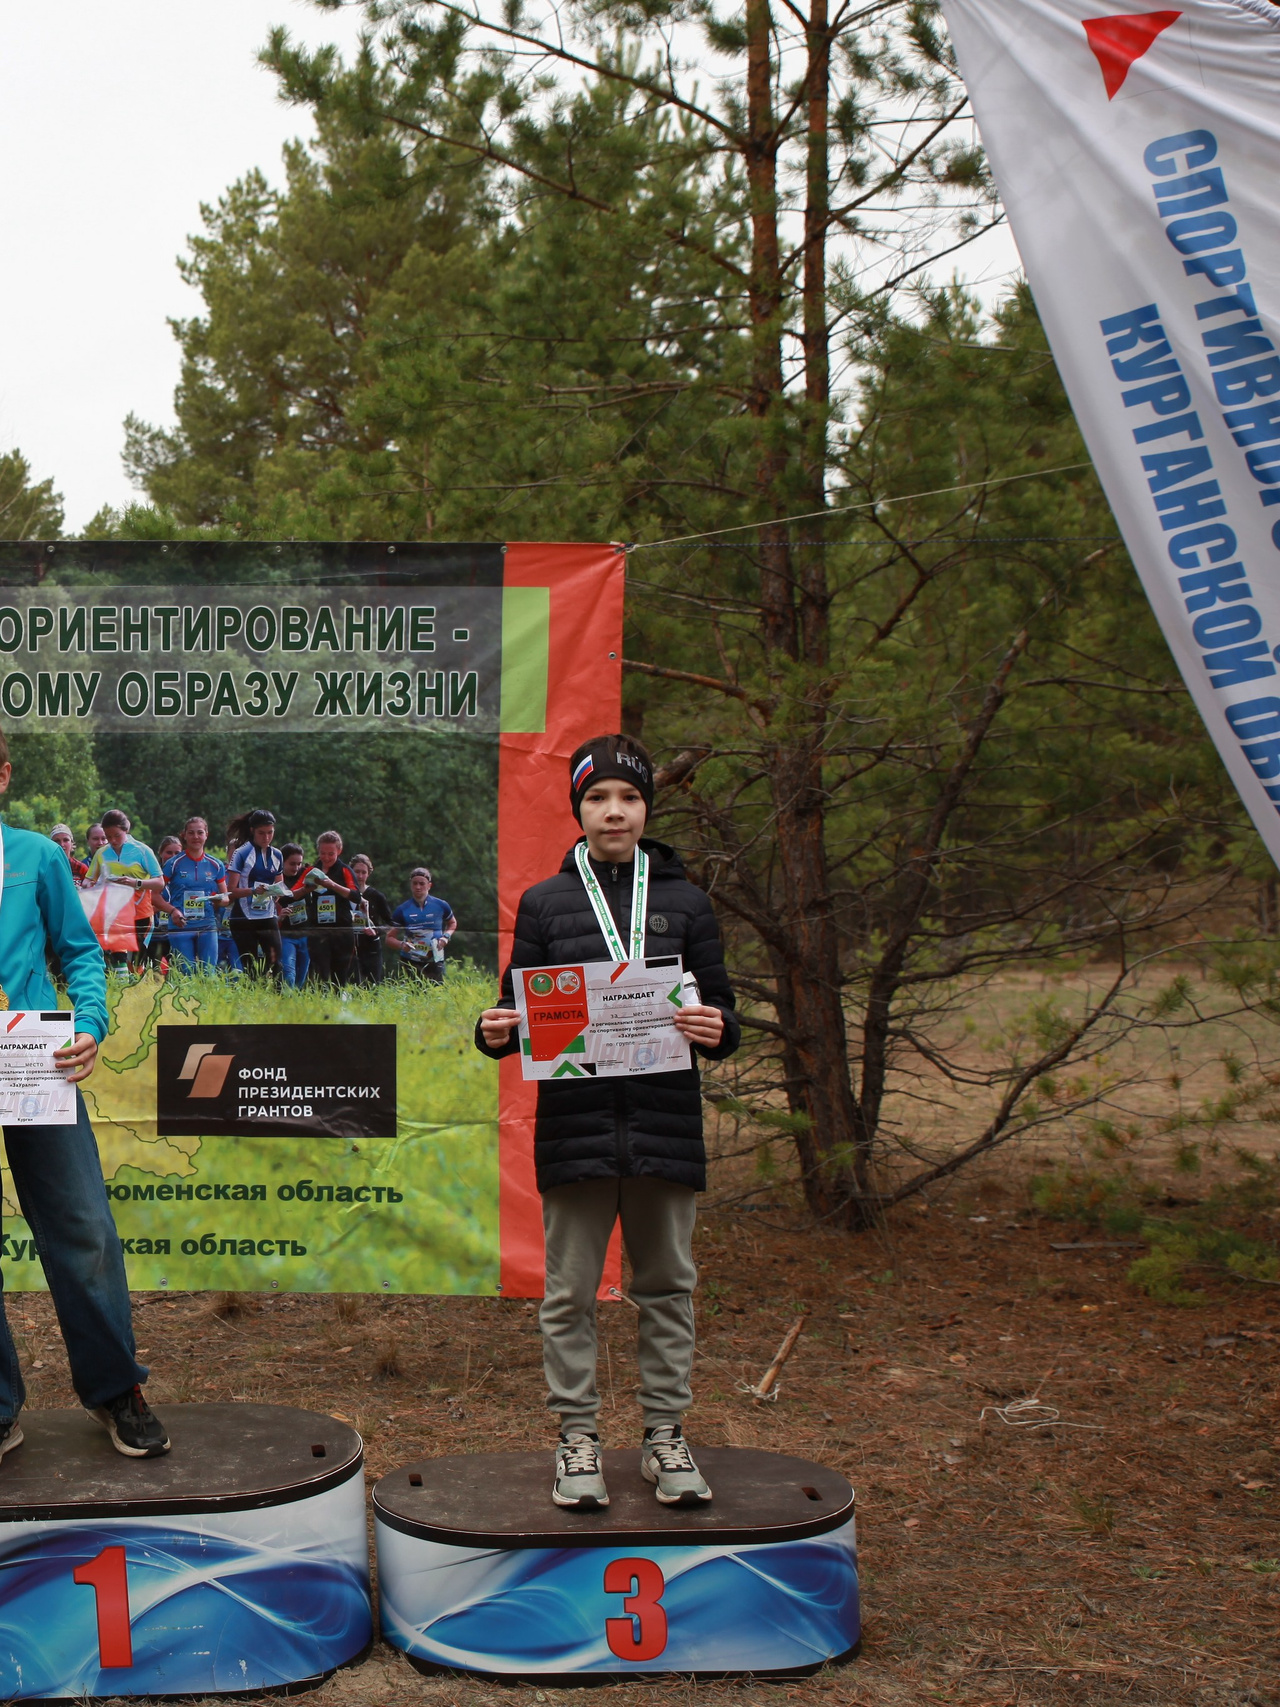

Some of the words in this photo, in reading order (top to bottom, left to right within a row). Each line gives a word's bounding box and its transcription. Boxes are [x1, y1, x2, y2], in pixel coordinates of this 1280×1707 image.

[452, 627, 471, 641] -
[116, 671, 299, 718] ОБРАЗУ
[313, 670, 479, 718] ЖИЗНИ
[1224, 696, 1280, 816] ОБ
[602, 991, 655, 1002] НАГРАЖДАЕТ
[533, 1009, 584, 1022] ГРАМОТА
[632, 1022, 676, 1031] ориентировани
[237, 1067, 287, 1082] ФОНД
[237, 1085, 381, 1101] ПРЕЗИДЕНТСКИХ
[237, 1104, 314, 1119] ГРАНТОВ
[105, 1182, 267, 1202] юменская
[277, 1180, 404, 1204] область
[180, 1233, 308, 1257] область
[73, 1545, 133, 1669] 1
[603, 1557, 668, 1662] 3
